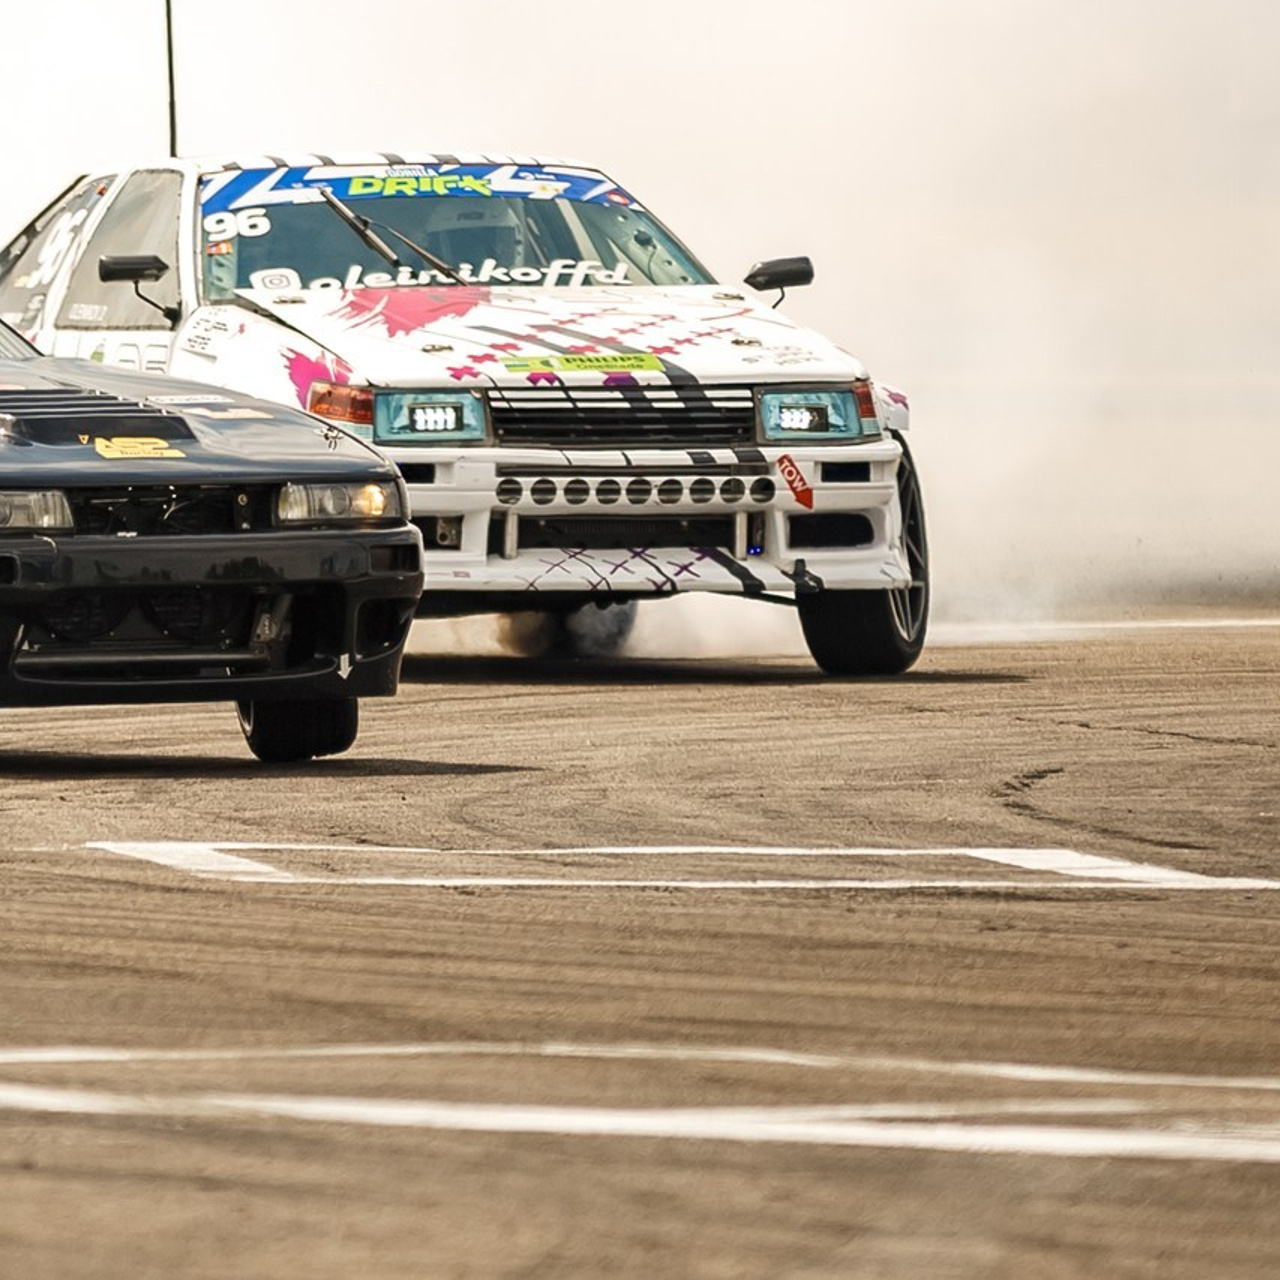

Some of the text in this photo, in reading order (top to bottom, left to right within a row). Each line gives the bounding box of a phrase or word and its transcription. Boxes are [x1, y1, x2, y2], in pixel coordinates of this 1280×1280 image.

[204, 208, 270, 241] 96
[564, 355, 646, 364] PHILIPS
[780, 459, 809, 492] TOW
